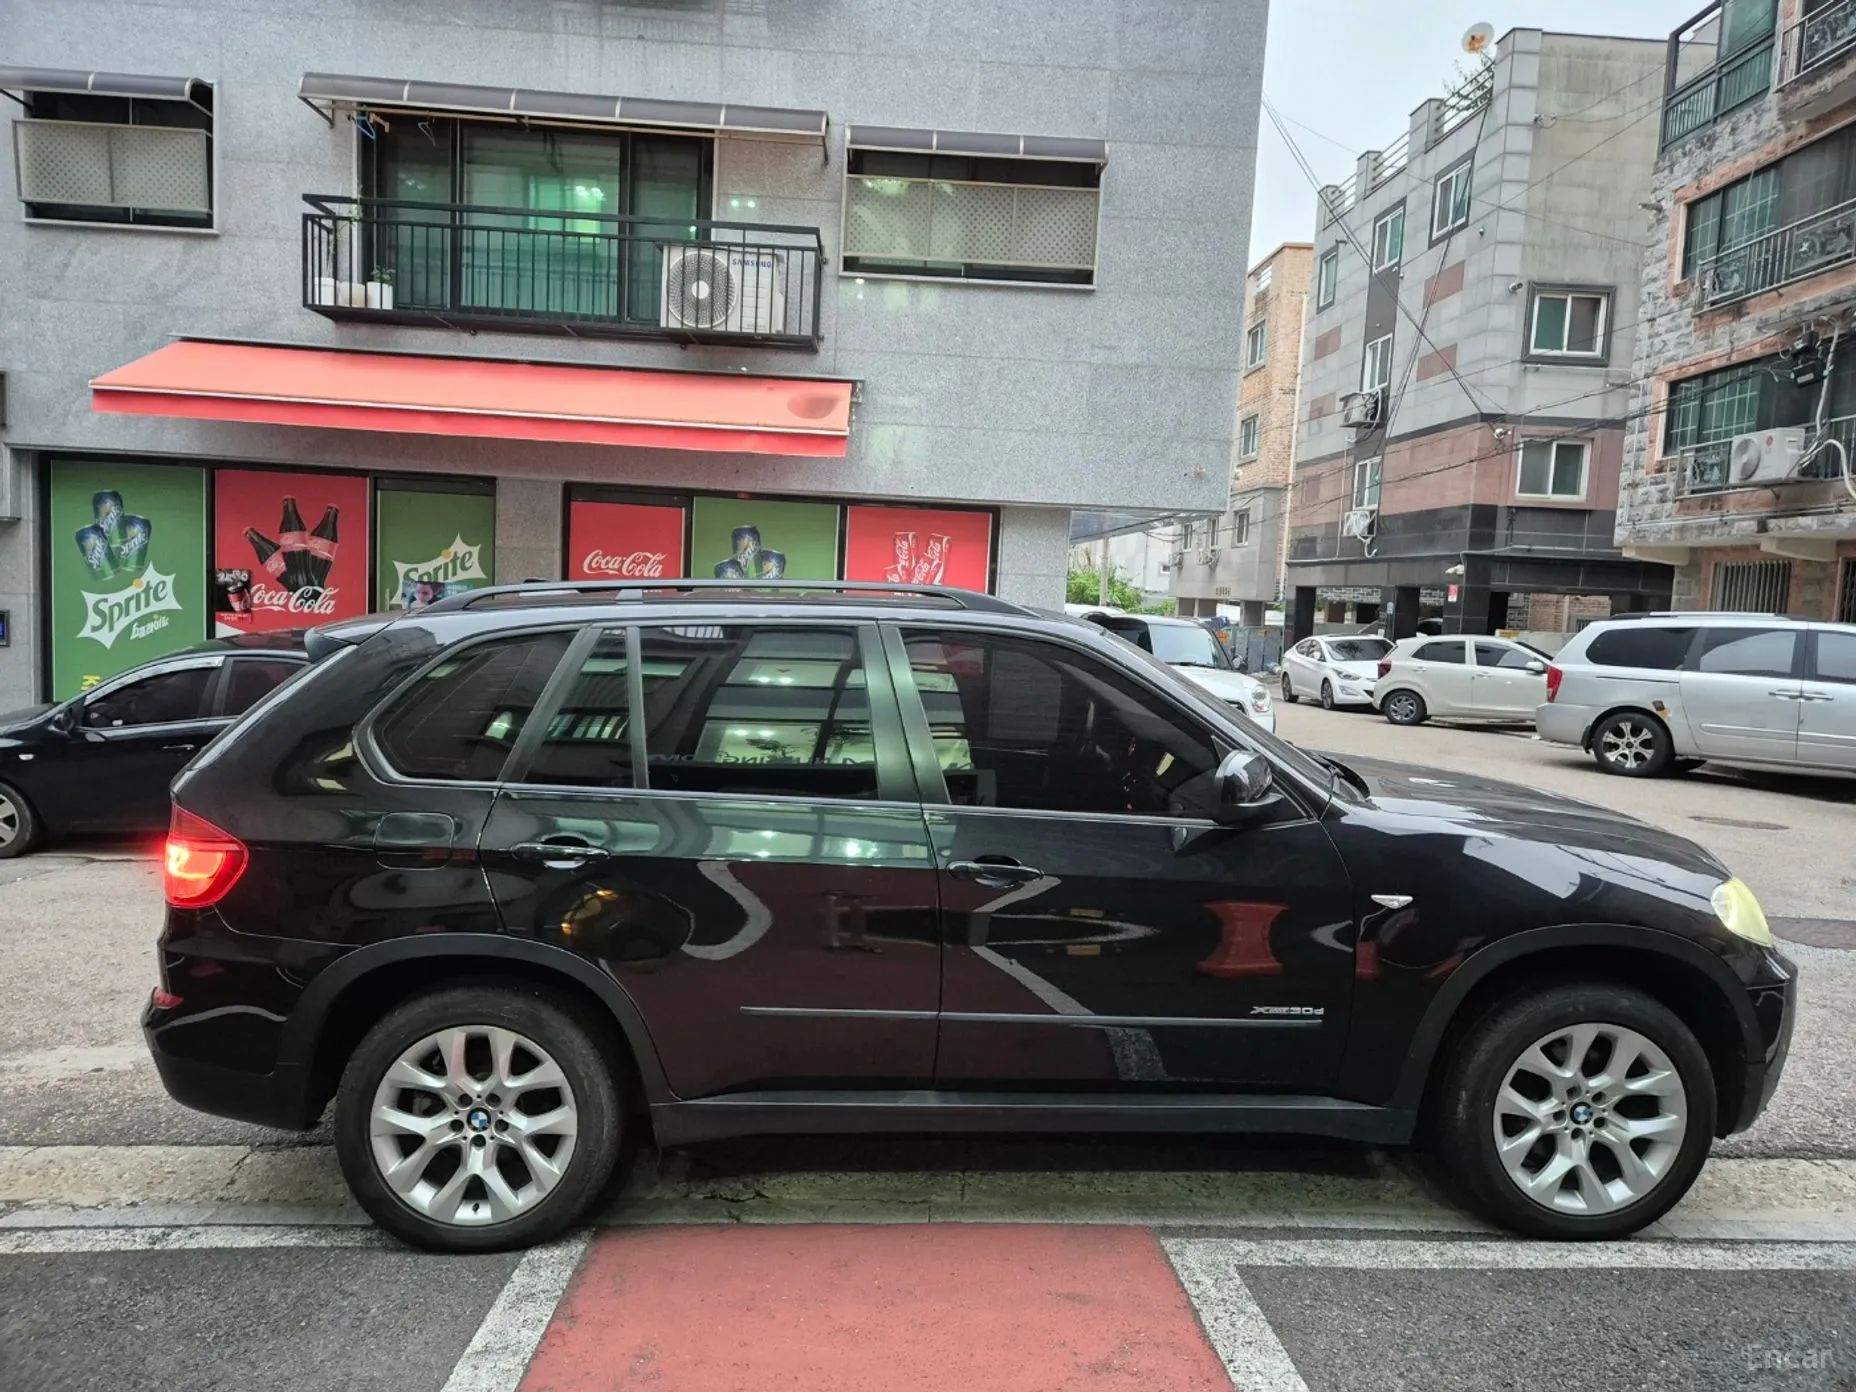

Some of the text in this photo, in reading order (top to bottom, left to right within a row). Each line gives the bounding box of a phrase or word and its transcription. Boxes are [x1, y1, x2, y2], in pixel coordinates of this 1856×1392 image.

[731, 258, 772, 268] SAMSNG
[582, 548, 667, 578] Coca-Cola
[90, 577, 168, 633] Sprite
[250, 583, 340, 615] Coca-Cola
